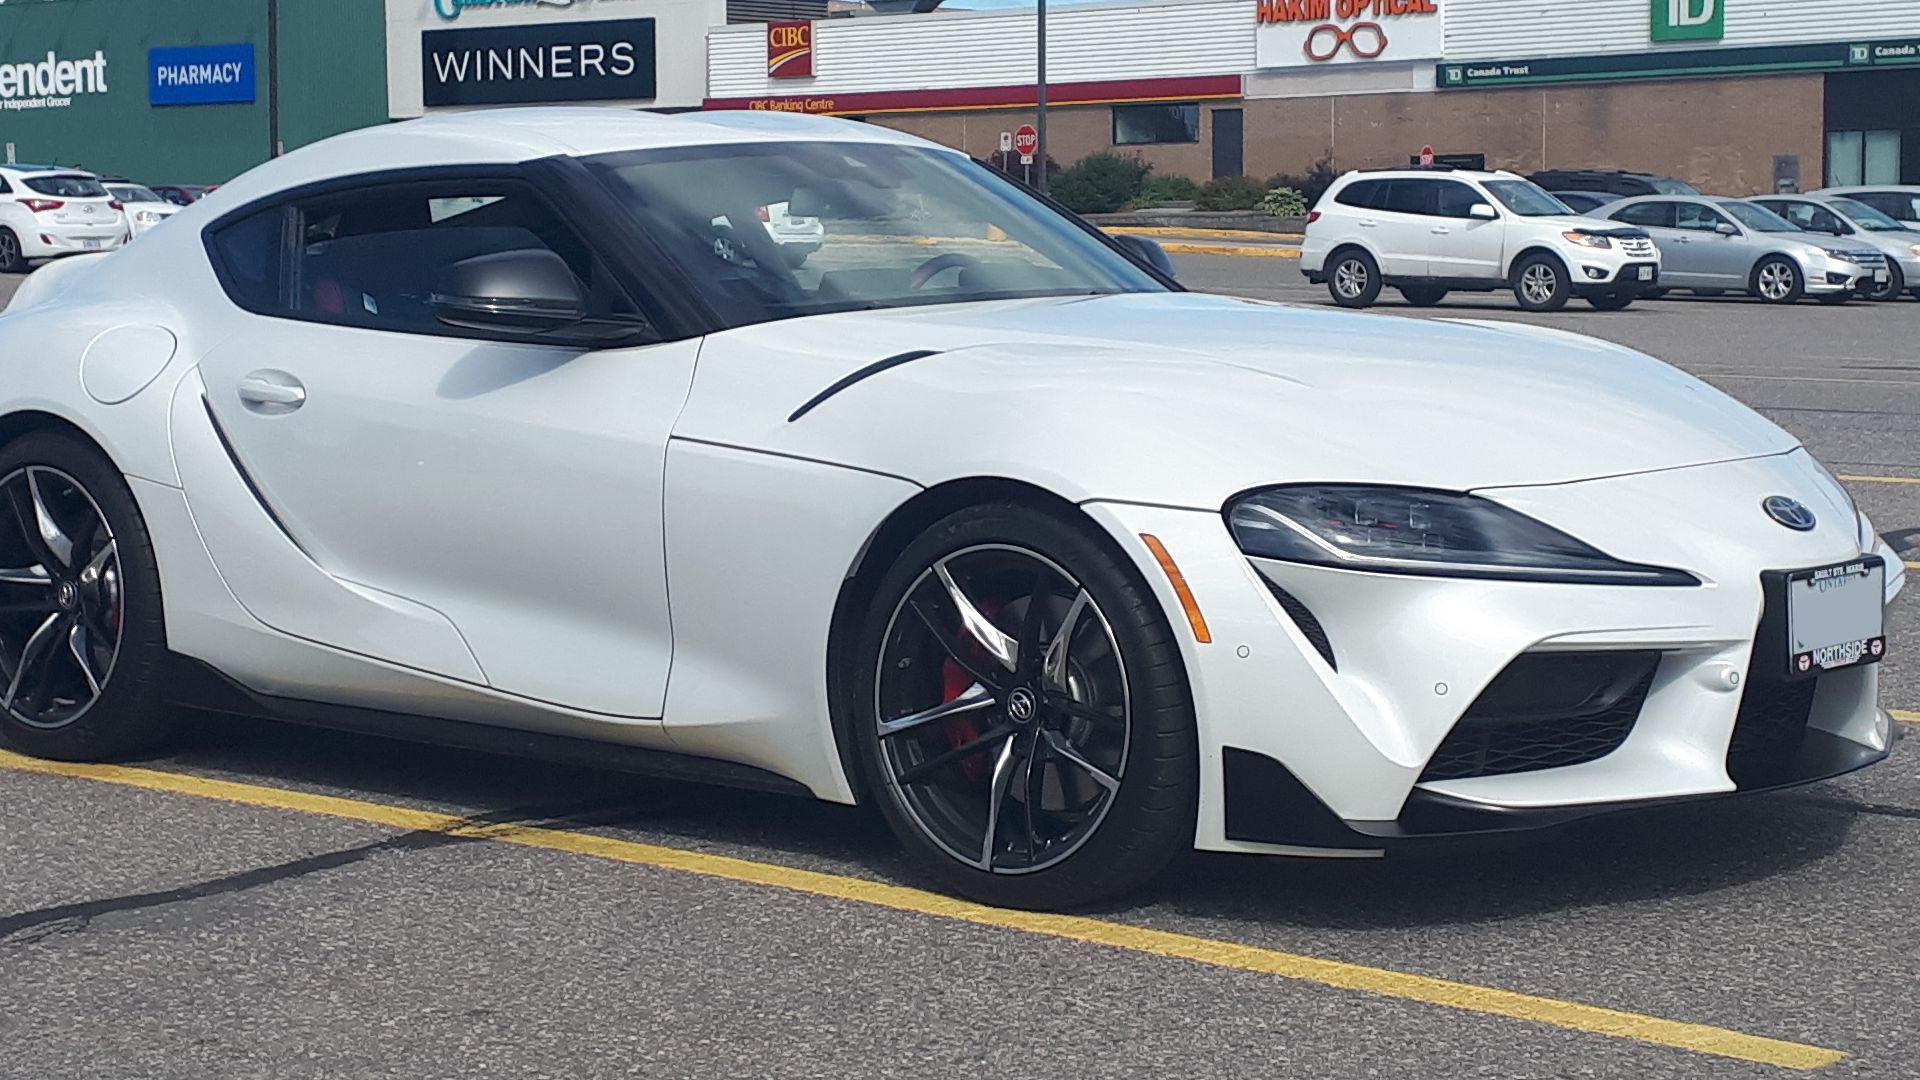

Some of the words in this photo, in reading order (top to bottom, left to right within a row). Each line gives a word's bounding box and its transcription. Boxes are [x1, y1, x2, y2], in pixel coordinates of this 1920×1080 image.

[1257, 0, 1330, 23] HAKIM
[1336, 0, 1437, 18] OPTICAL
[770, 26, 809, 47] CIBC
[433, 42, 635, 83] WINNERS
[1851, 47, 1868, 60] TD
[1875, 45, 1915, 56] Canada
[0, 50, 107, 97] endent
[157, 62, 241, 86] PHARMACY
[1447, 68, 1461, 81] TD
[1467, 67, 1501, 77] Canada
[1503, 66, 1529, 75] Trust
[4, 97, 46, 111] Independent
[46, 96, 71, 108] Grocer
[749, 100, 768, 110] CIBC
[770, 99, 803, 112] Banking
[805, 99, 834, 110] Centre
[1017, 135, 1035, 146] STOP
[1813, 640, 1868, 666] NORTHSIDE
